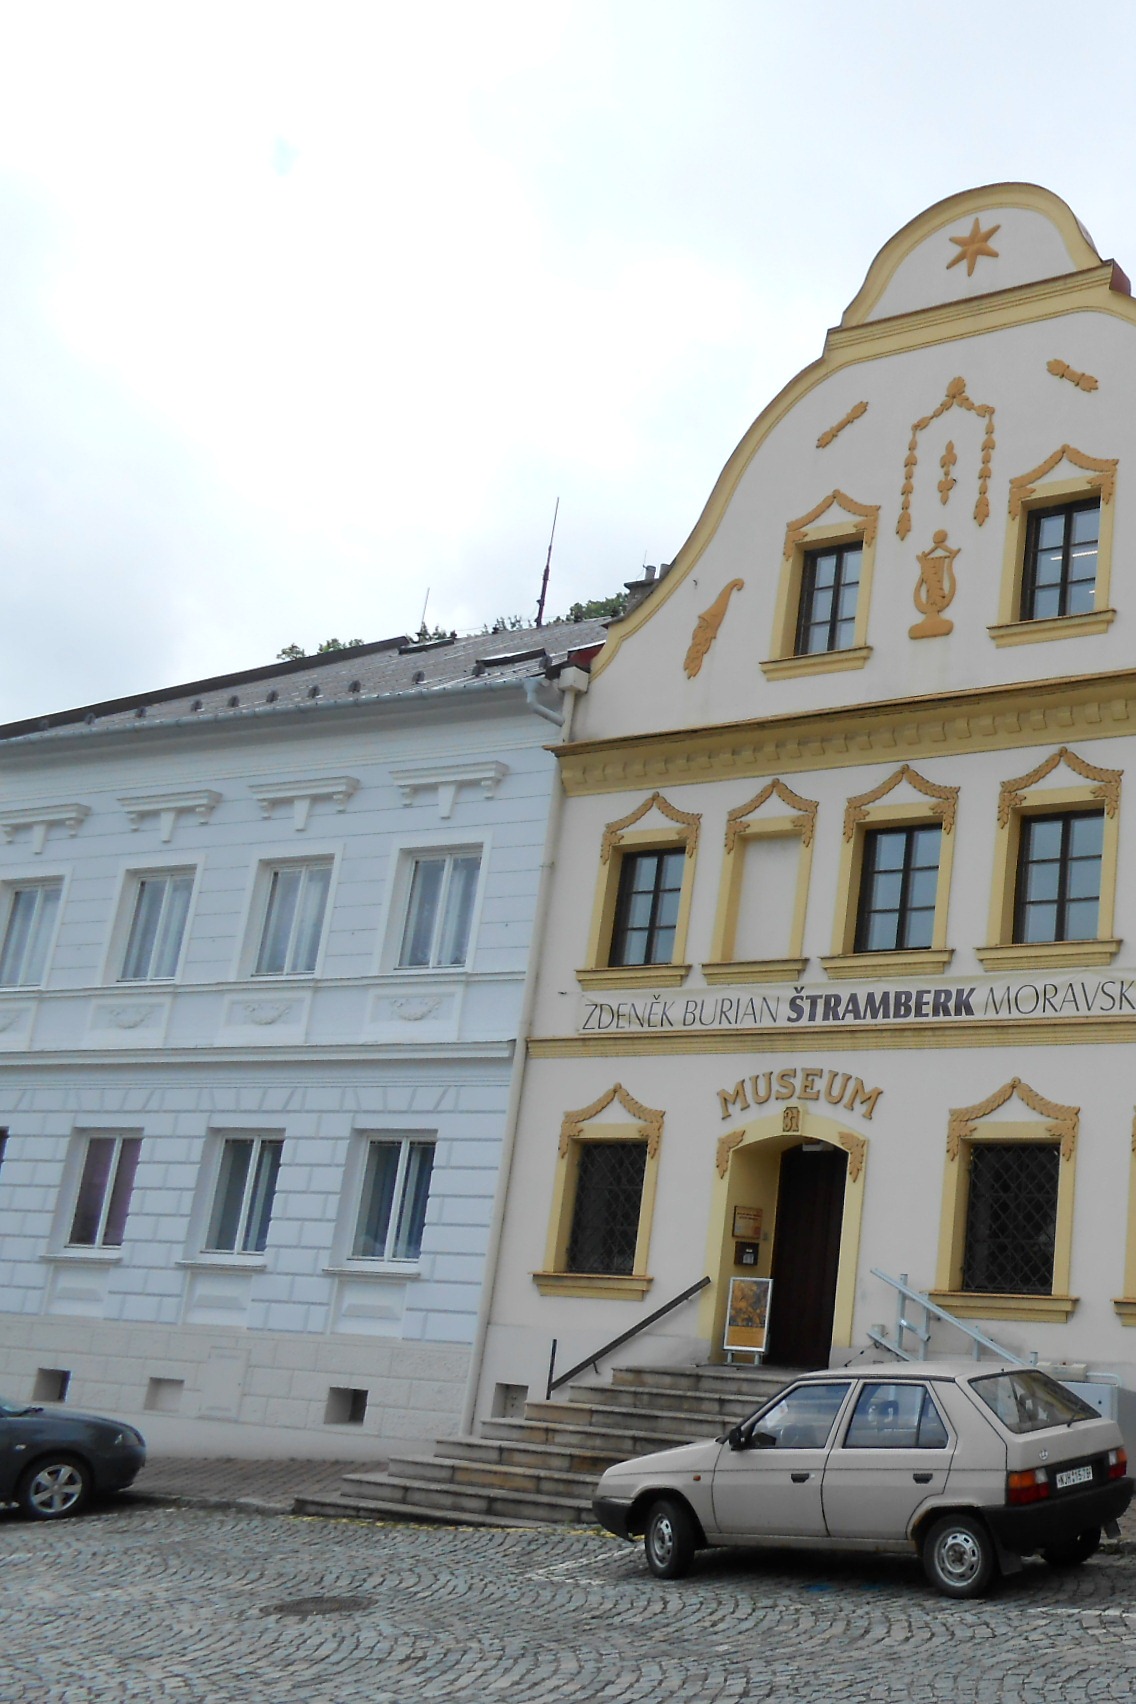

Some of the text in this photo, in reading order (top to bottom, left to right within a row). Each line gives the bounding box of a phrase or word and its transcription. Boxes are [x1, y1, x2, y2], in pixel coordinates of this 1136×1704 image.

[582, 995, 675, 1029] ZDENĚK
[683, 996, 779, 1026] BURIAN
[787, 986, 976, 1022] ŠTRAMBERK
[717, 1068, 884, 1120] MUSEUM
